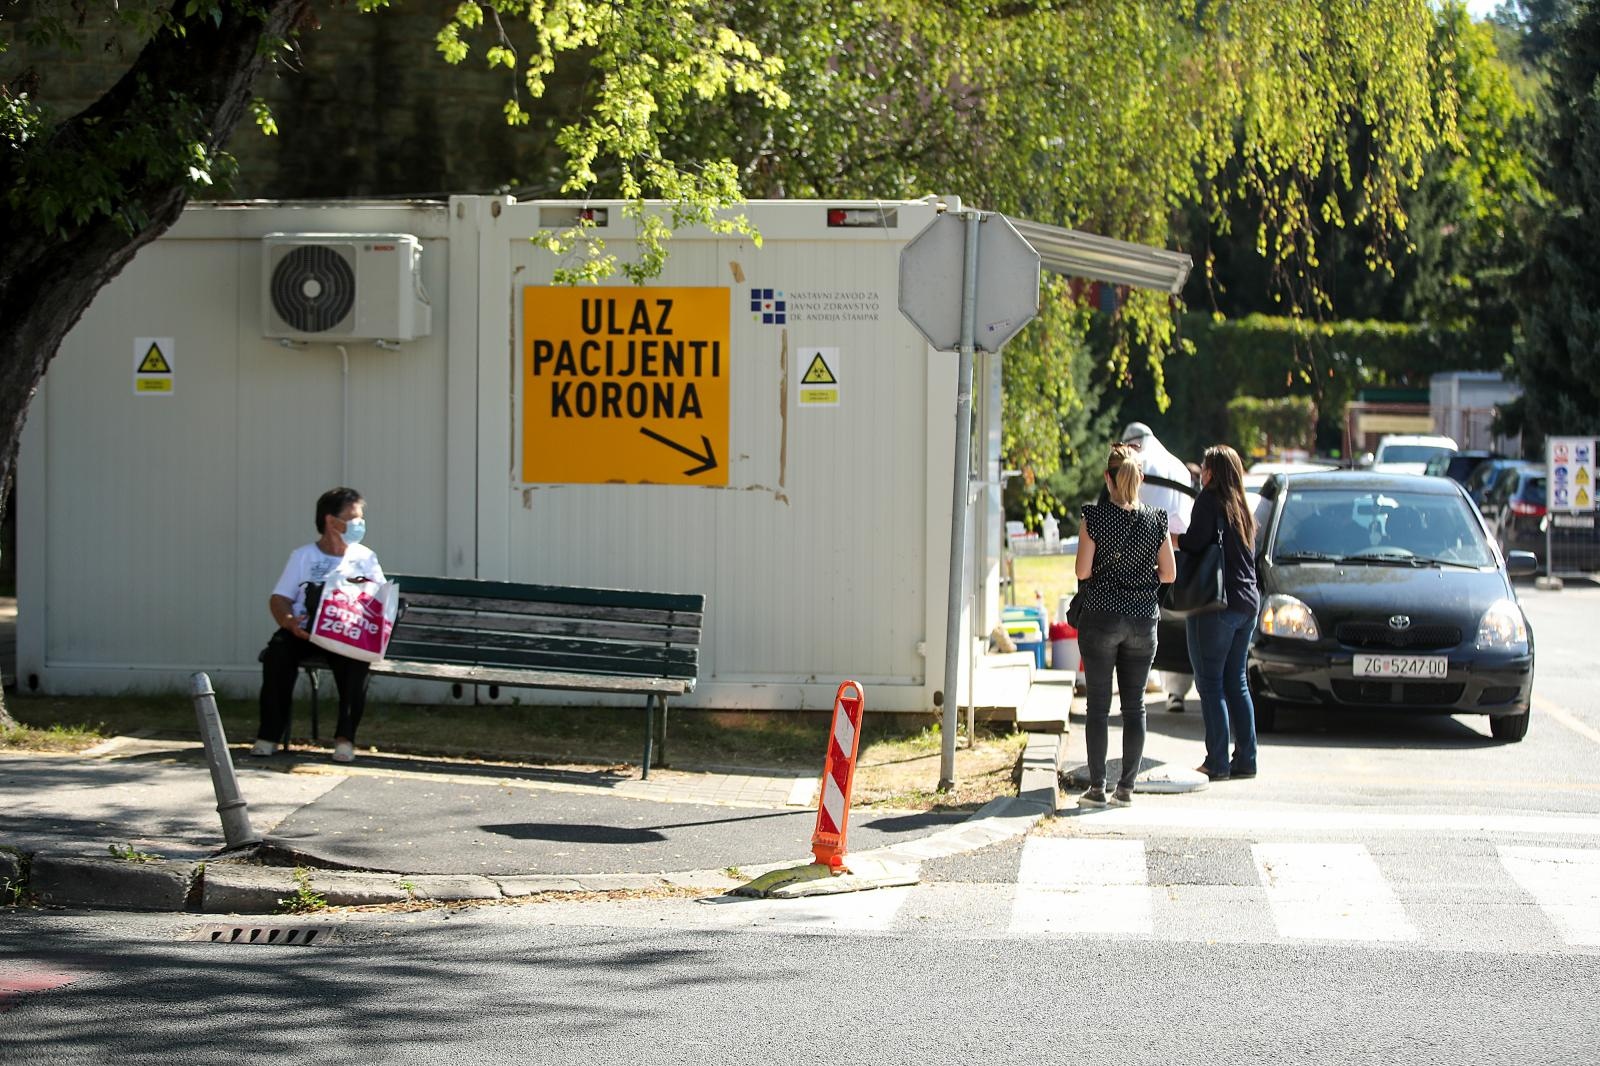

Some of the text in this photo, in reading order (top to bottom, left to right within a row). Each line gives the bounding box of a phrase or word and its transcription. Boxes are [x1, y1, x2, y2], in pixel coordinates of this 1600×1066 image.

[790, 292, 879, 300] NASTAVNI ZAVOD ZA
[790, 303, 880, 311] JAVNO ZDRAVSTVO
[581, 298, 674, 336] ULAZ
[806, 313, 841, 322] ANDRIJA
[533, 340, 721, 378] PACIJENTI
[551, 381, 703, 419] KORONA
[320, 618, 362, 640] zeta
[1364, 657, 1382, 674] ZG
